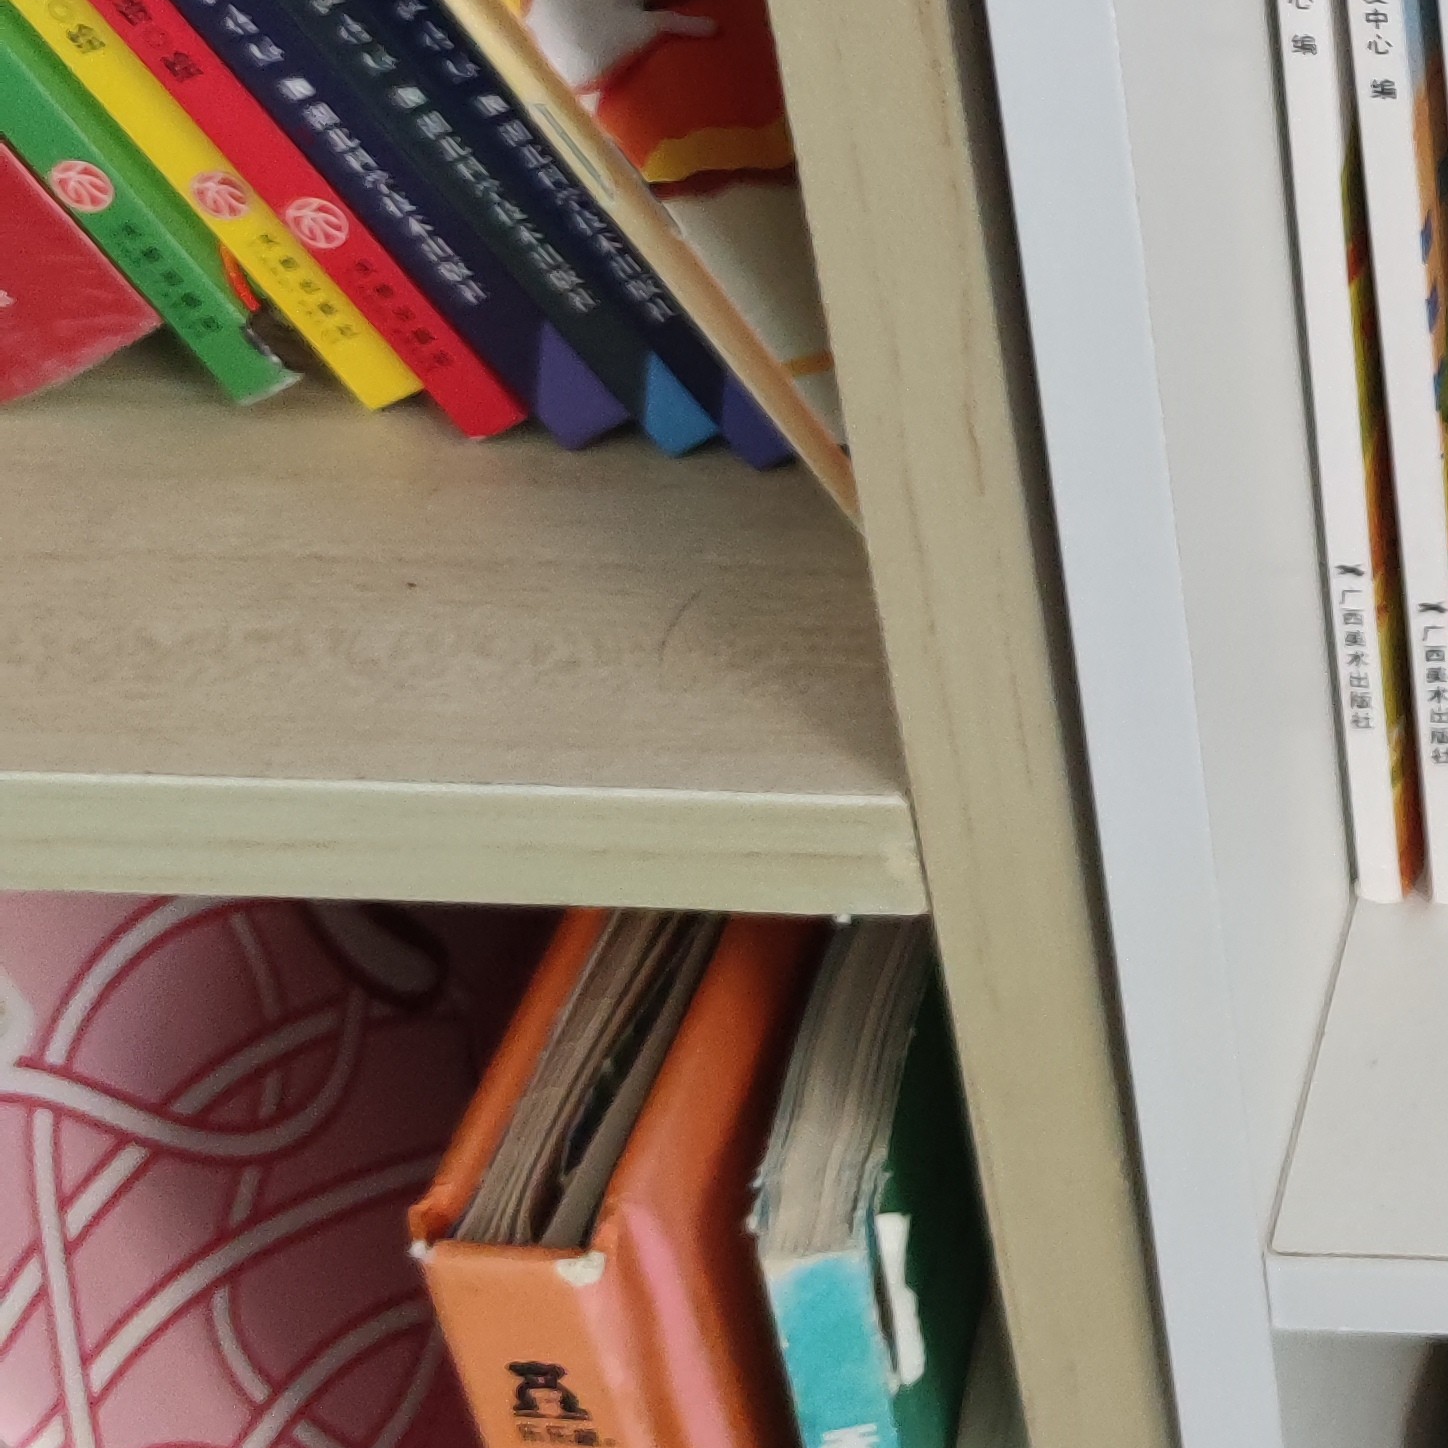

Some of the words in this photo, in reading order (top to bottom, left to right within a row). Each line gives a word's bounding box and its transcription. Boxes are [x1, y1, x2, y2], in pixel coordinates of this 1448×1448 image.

[1339, 586, 1376, 731] 广西美术出版社
